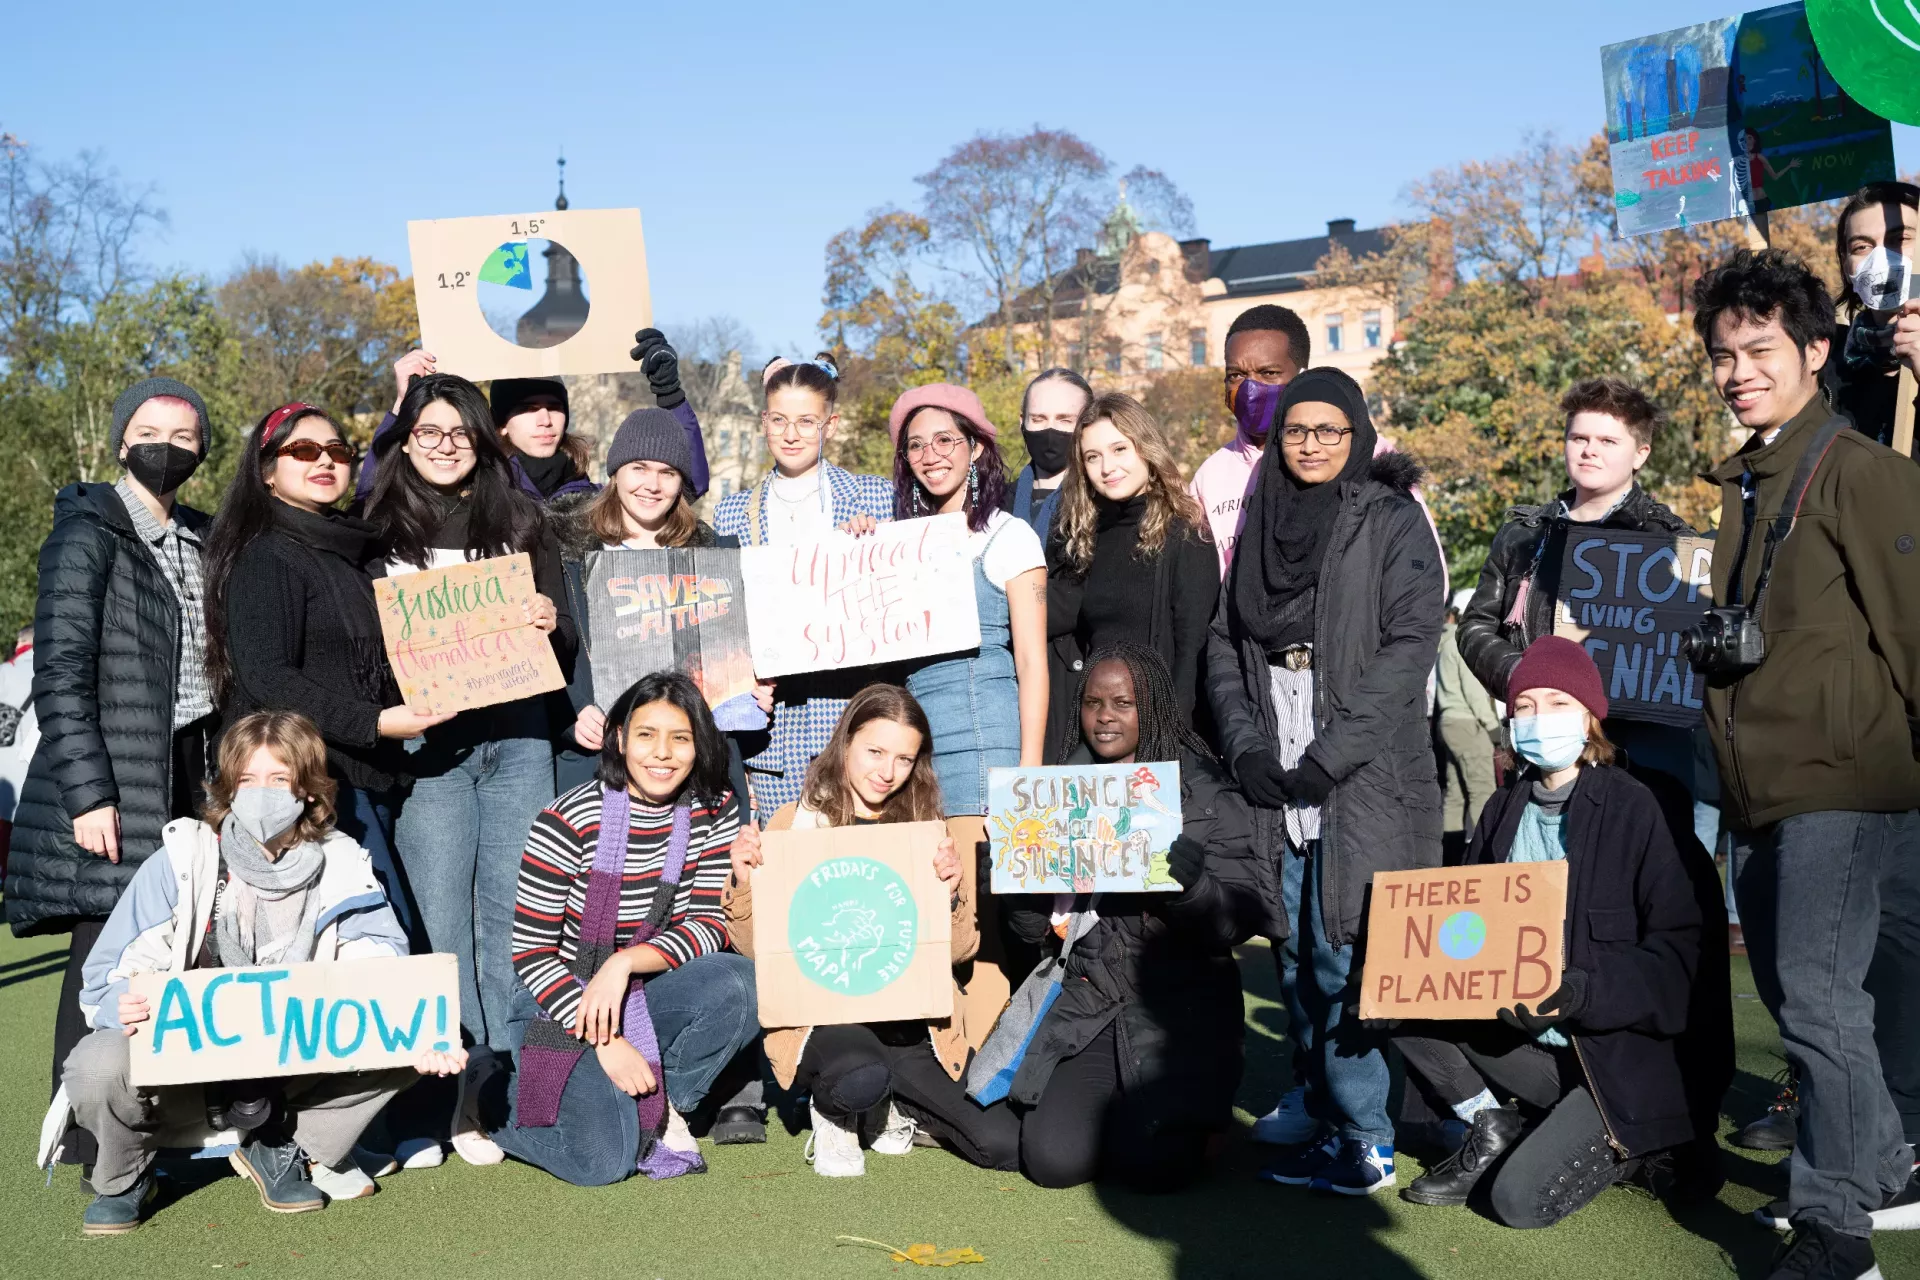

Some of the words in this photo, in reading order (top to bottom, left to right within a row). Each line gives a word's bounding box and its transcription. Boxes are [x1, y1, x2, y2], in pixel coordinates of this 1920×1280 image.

[1651, 131, 1700, 161] KEEP
[1811, 151, 1856, 170] NOW
[1642, 157, 1723, 190] TALKING
[510, 219, 546, 236] 1,5°
[438, 271, 471, 290] 1,2°
[1570, 538, 1714, 604] STOP
[607, 573, 700, 617] SAVE
[828, 574, 903, 620] THE
[639, 597, 732, 643] FUTURE
[1561, 599, 1656, 635] LIVING
[1012, 774, 1141, 812] SCIENCE
[1054, 819, 1097, 839] NOT
[810, 861, 880, 888] FRIDAYS
[1385, 878, 1481, 909] THERE
[1503, 874, 1531, 904] IS
[884, 882, 908, 907] FOR
[797, 936, 850, 988] MAPA
[877, 920, 913, 982] FUTURE
[1377, 969, 1507, 1003] PLANET
[1512, 926, 1553, 1000] B
[152, 970, 289, 1054] ACT
[278, 995, 450, 1066] NOW!
